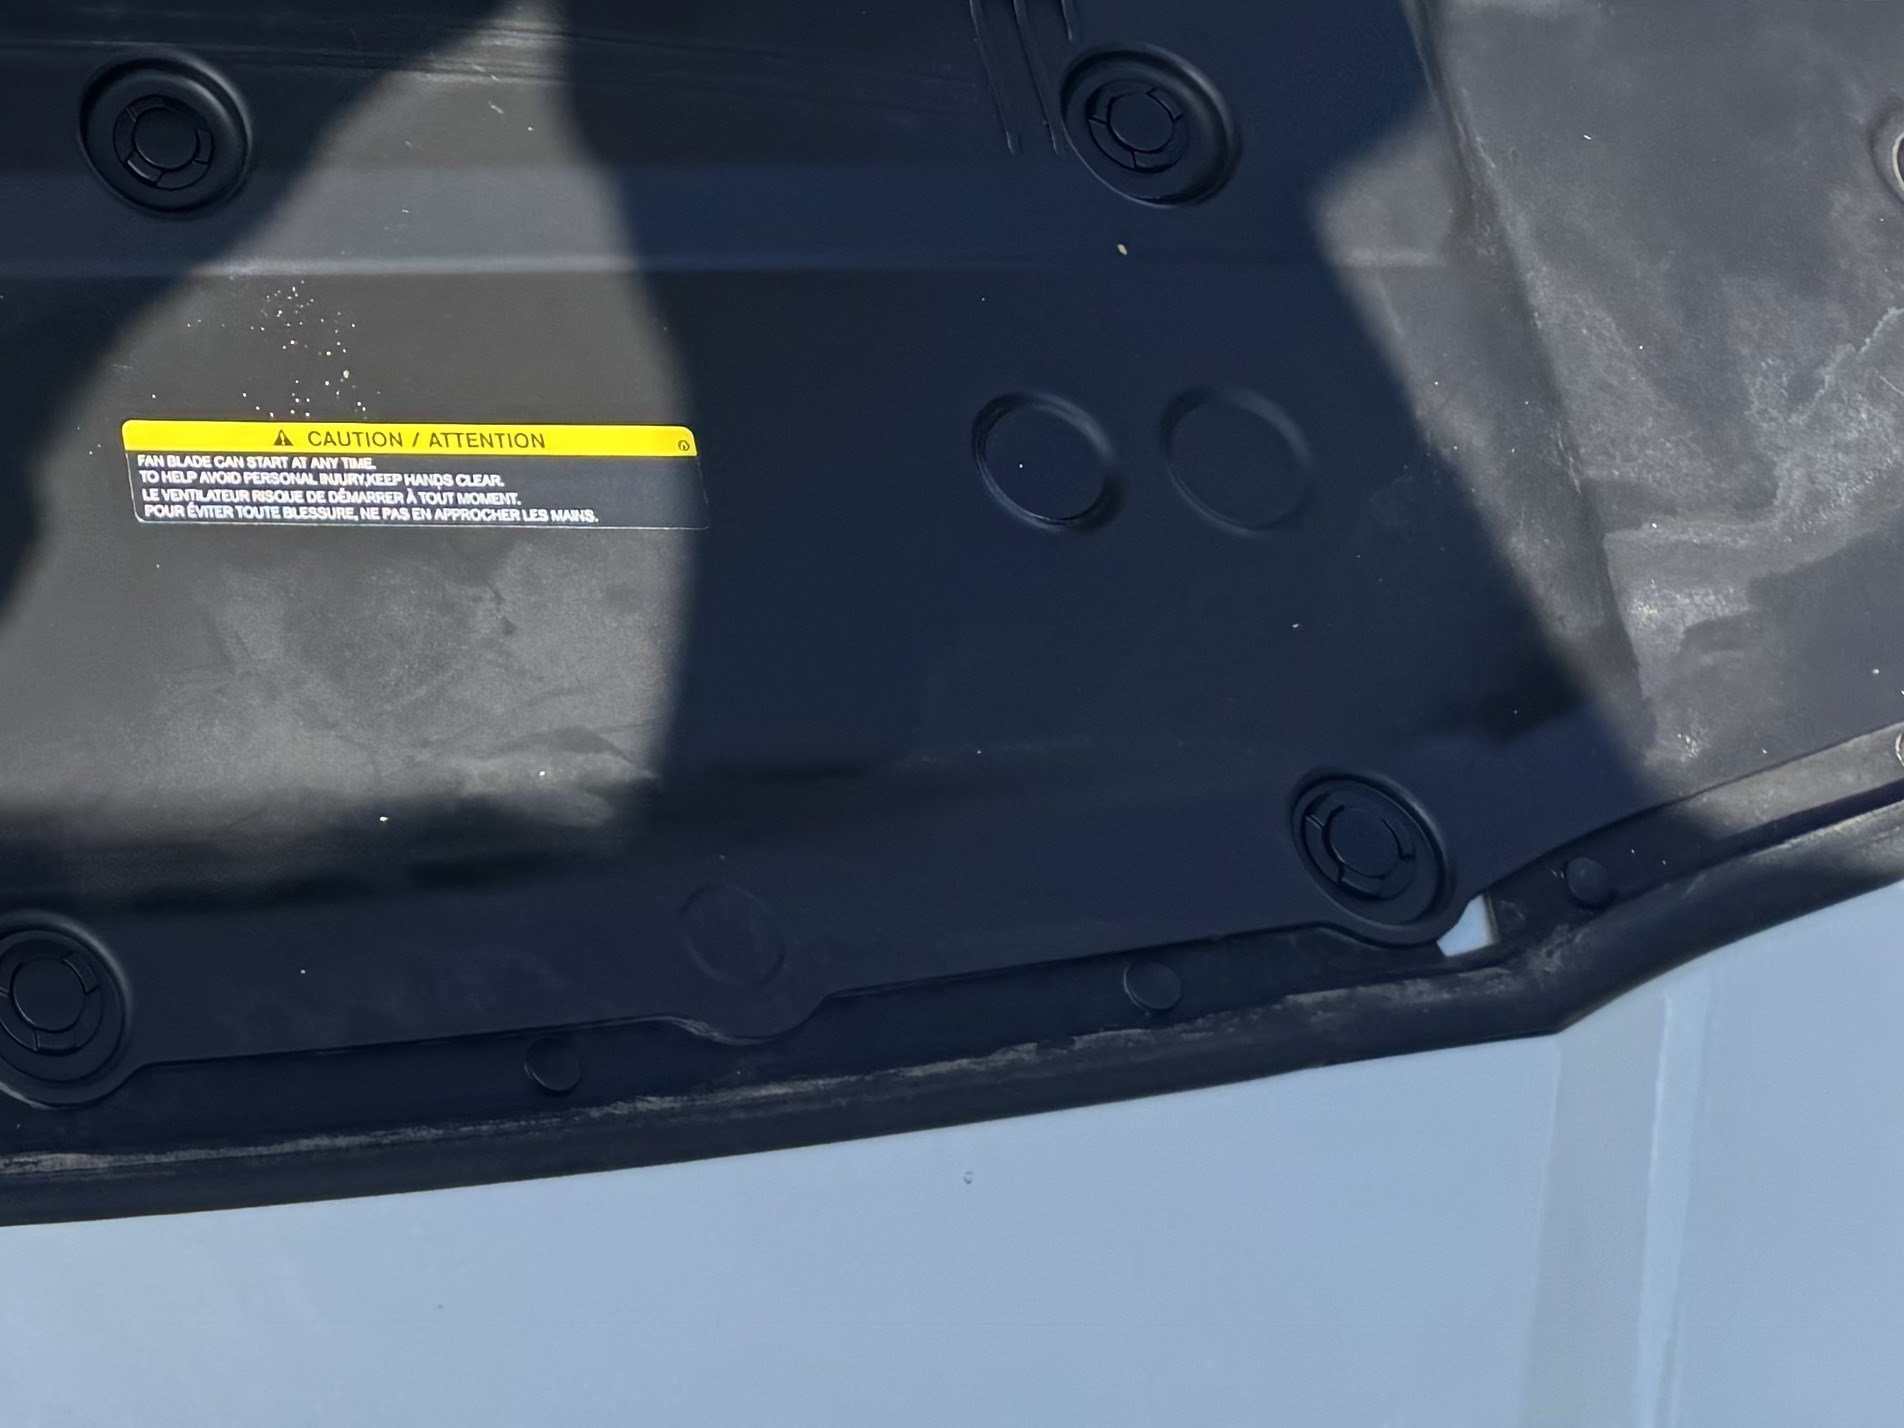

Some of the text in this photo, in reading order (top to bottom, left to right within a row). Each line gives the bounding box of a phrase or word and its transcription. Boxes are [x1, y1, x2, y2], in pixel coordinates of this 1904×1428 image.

[307, 431, 546, 449] CAUTION / ATTENTION
[138, 454, 377, 470] FAN BLADE CAN START AT ANY TIME.
[138, 470, 160, 484] TO
[162, 471, 198, 485] HELP
[199, 471, 242, 485] AVOID
[243, 471, 318, 485] PERSONAL
[404, 473, 453, 487] HANDS
[455, 474, 505, 488] CLEAR.
[142, 487, 522, 506] LE VENTILATEUR RISQUE DE DÉMARRER À TOUT MOMENT.
[144, 502, 600, 523] POUR ÉVITER TOUTE BLESSURE, NE PAS EN APPROCHER LES MAINS.
